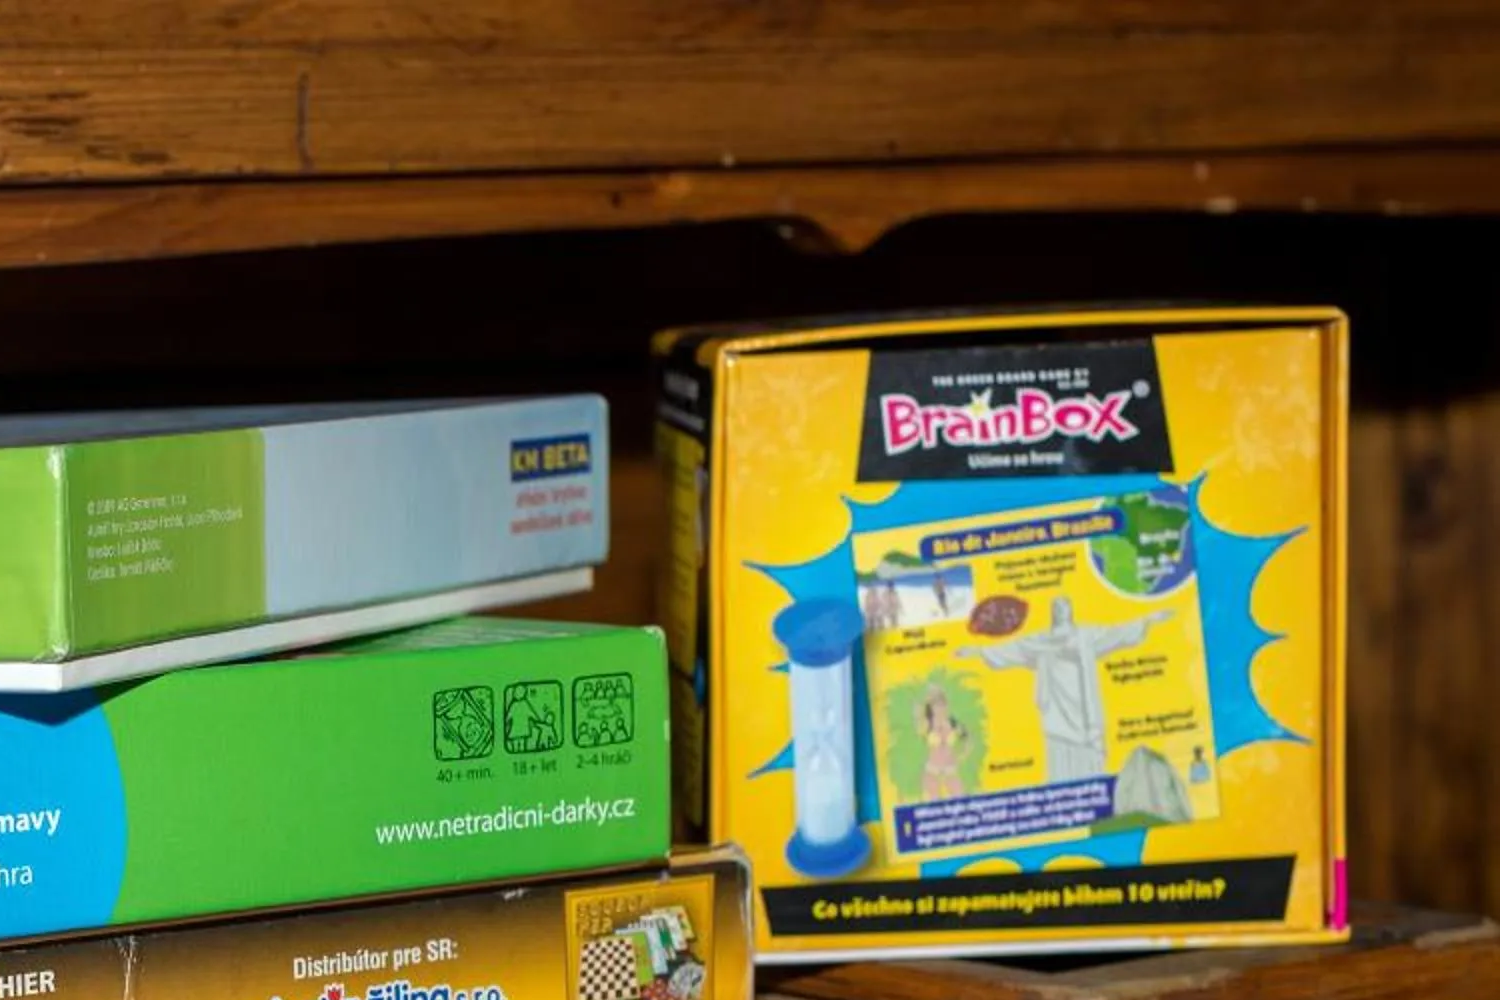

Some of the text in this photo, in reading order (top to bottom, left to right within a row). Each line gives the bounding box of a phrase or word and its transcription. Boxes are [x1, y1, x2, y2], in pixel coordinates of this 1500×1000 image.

[880, 388, 1140, 456] BrainBox
[376, 796, 636, 845] www.netradicni-darky.cz
[293, 938, 458, 980] Distribútor pre SR:
